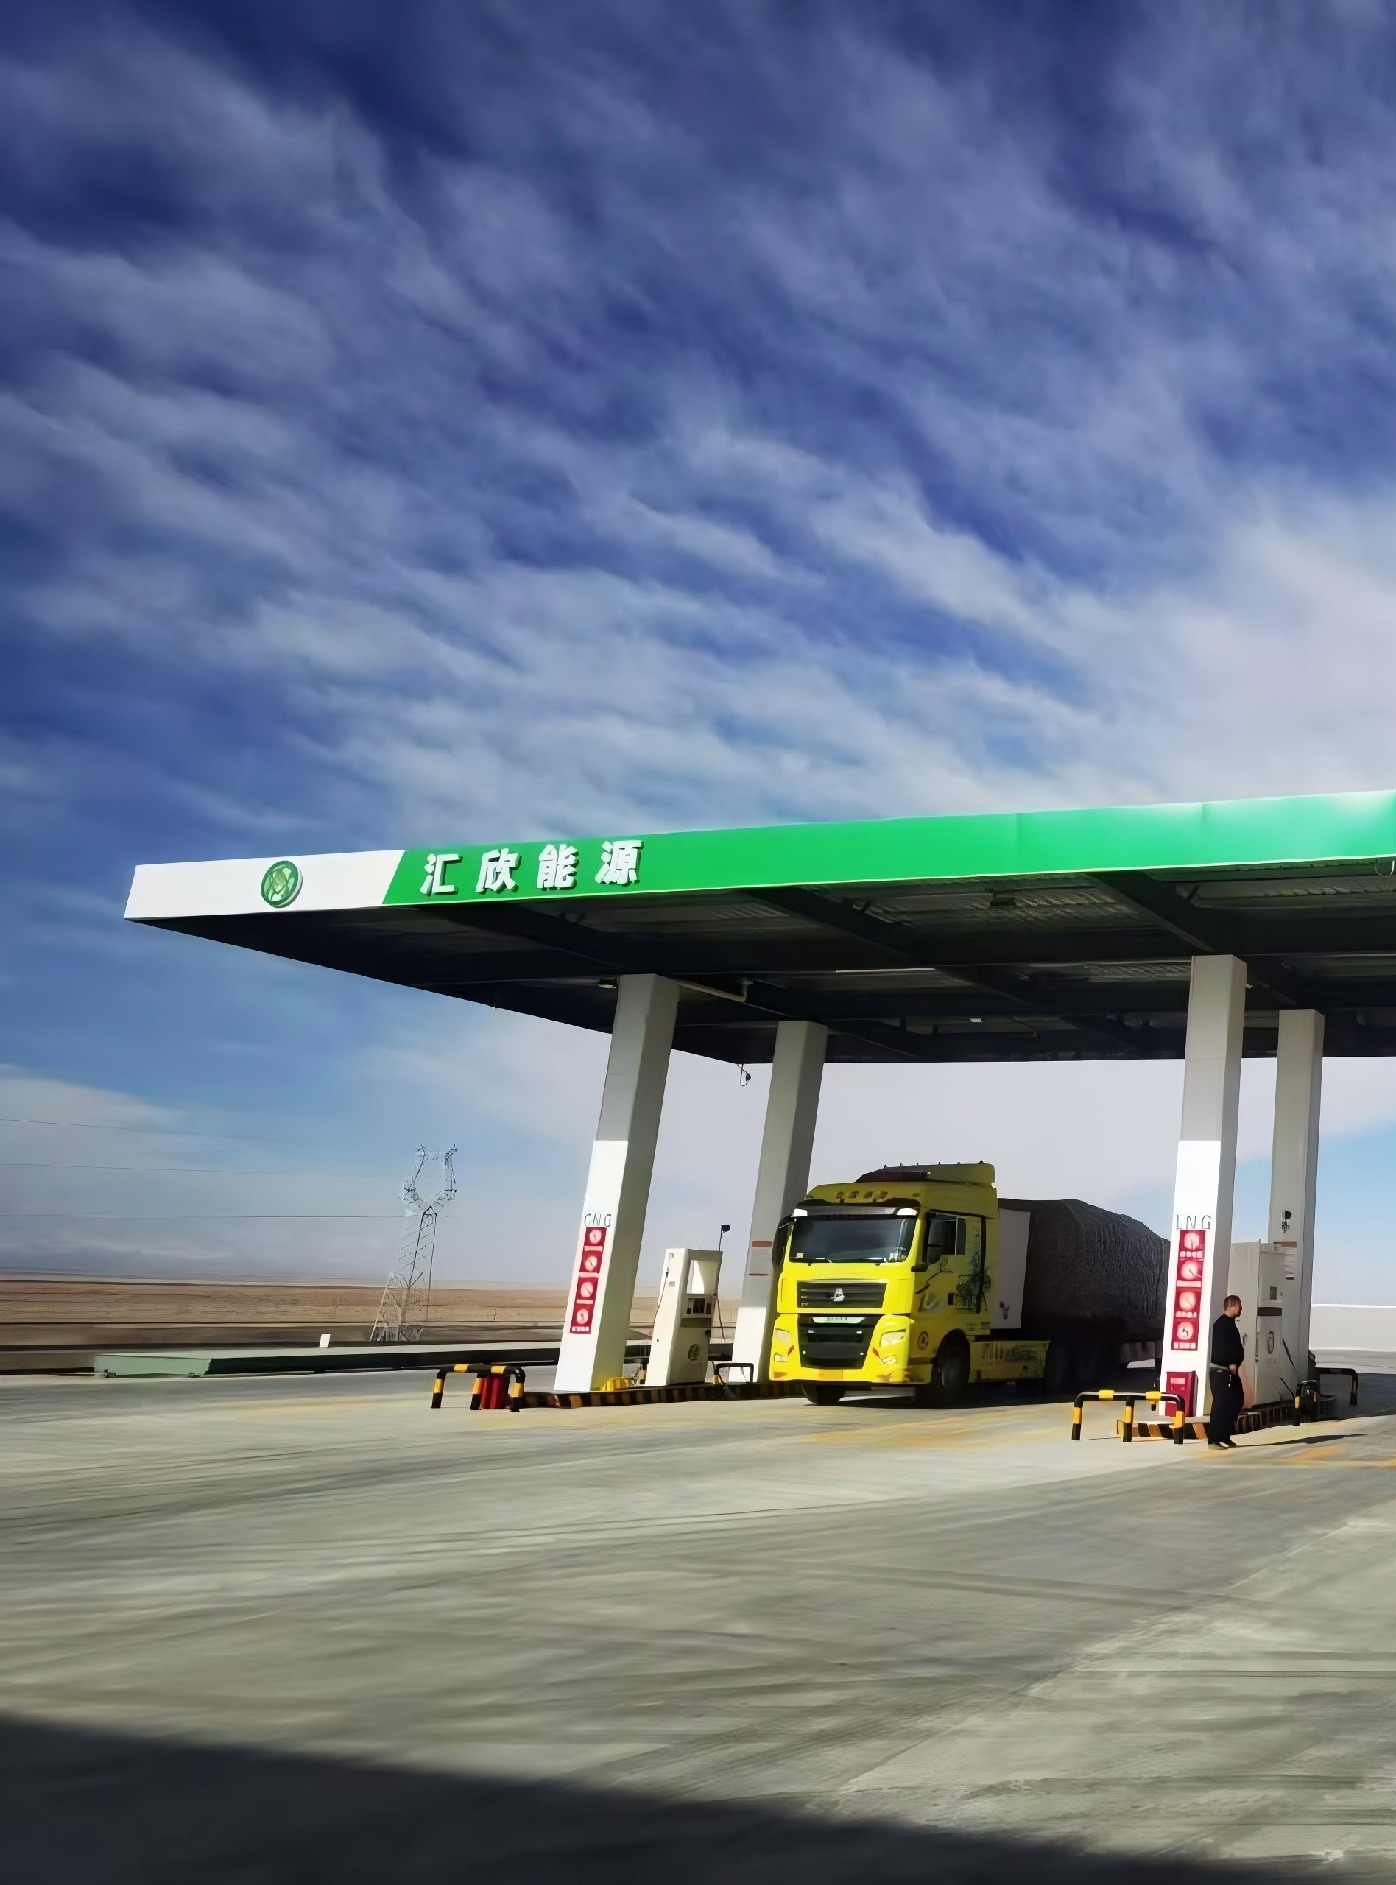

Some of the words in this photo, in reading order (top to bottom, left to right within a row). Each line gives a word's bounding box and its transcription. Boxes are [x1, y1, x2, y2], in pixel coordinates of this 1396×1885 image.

[419, 838, 646, 896] 汇欣能源
[584, 1213, 612, 1228] CNG
[1176, 1214, 1212, 1230] LNG
